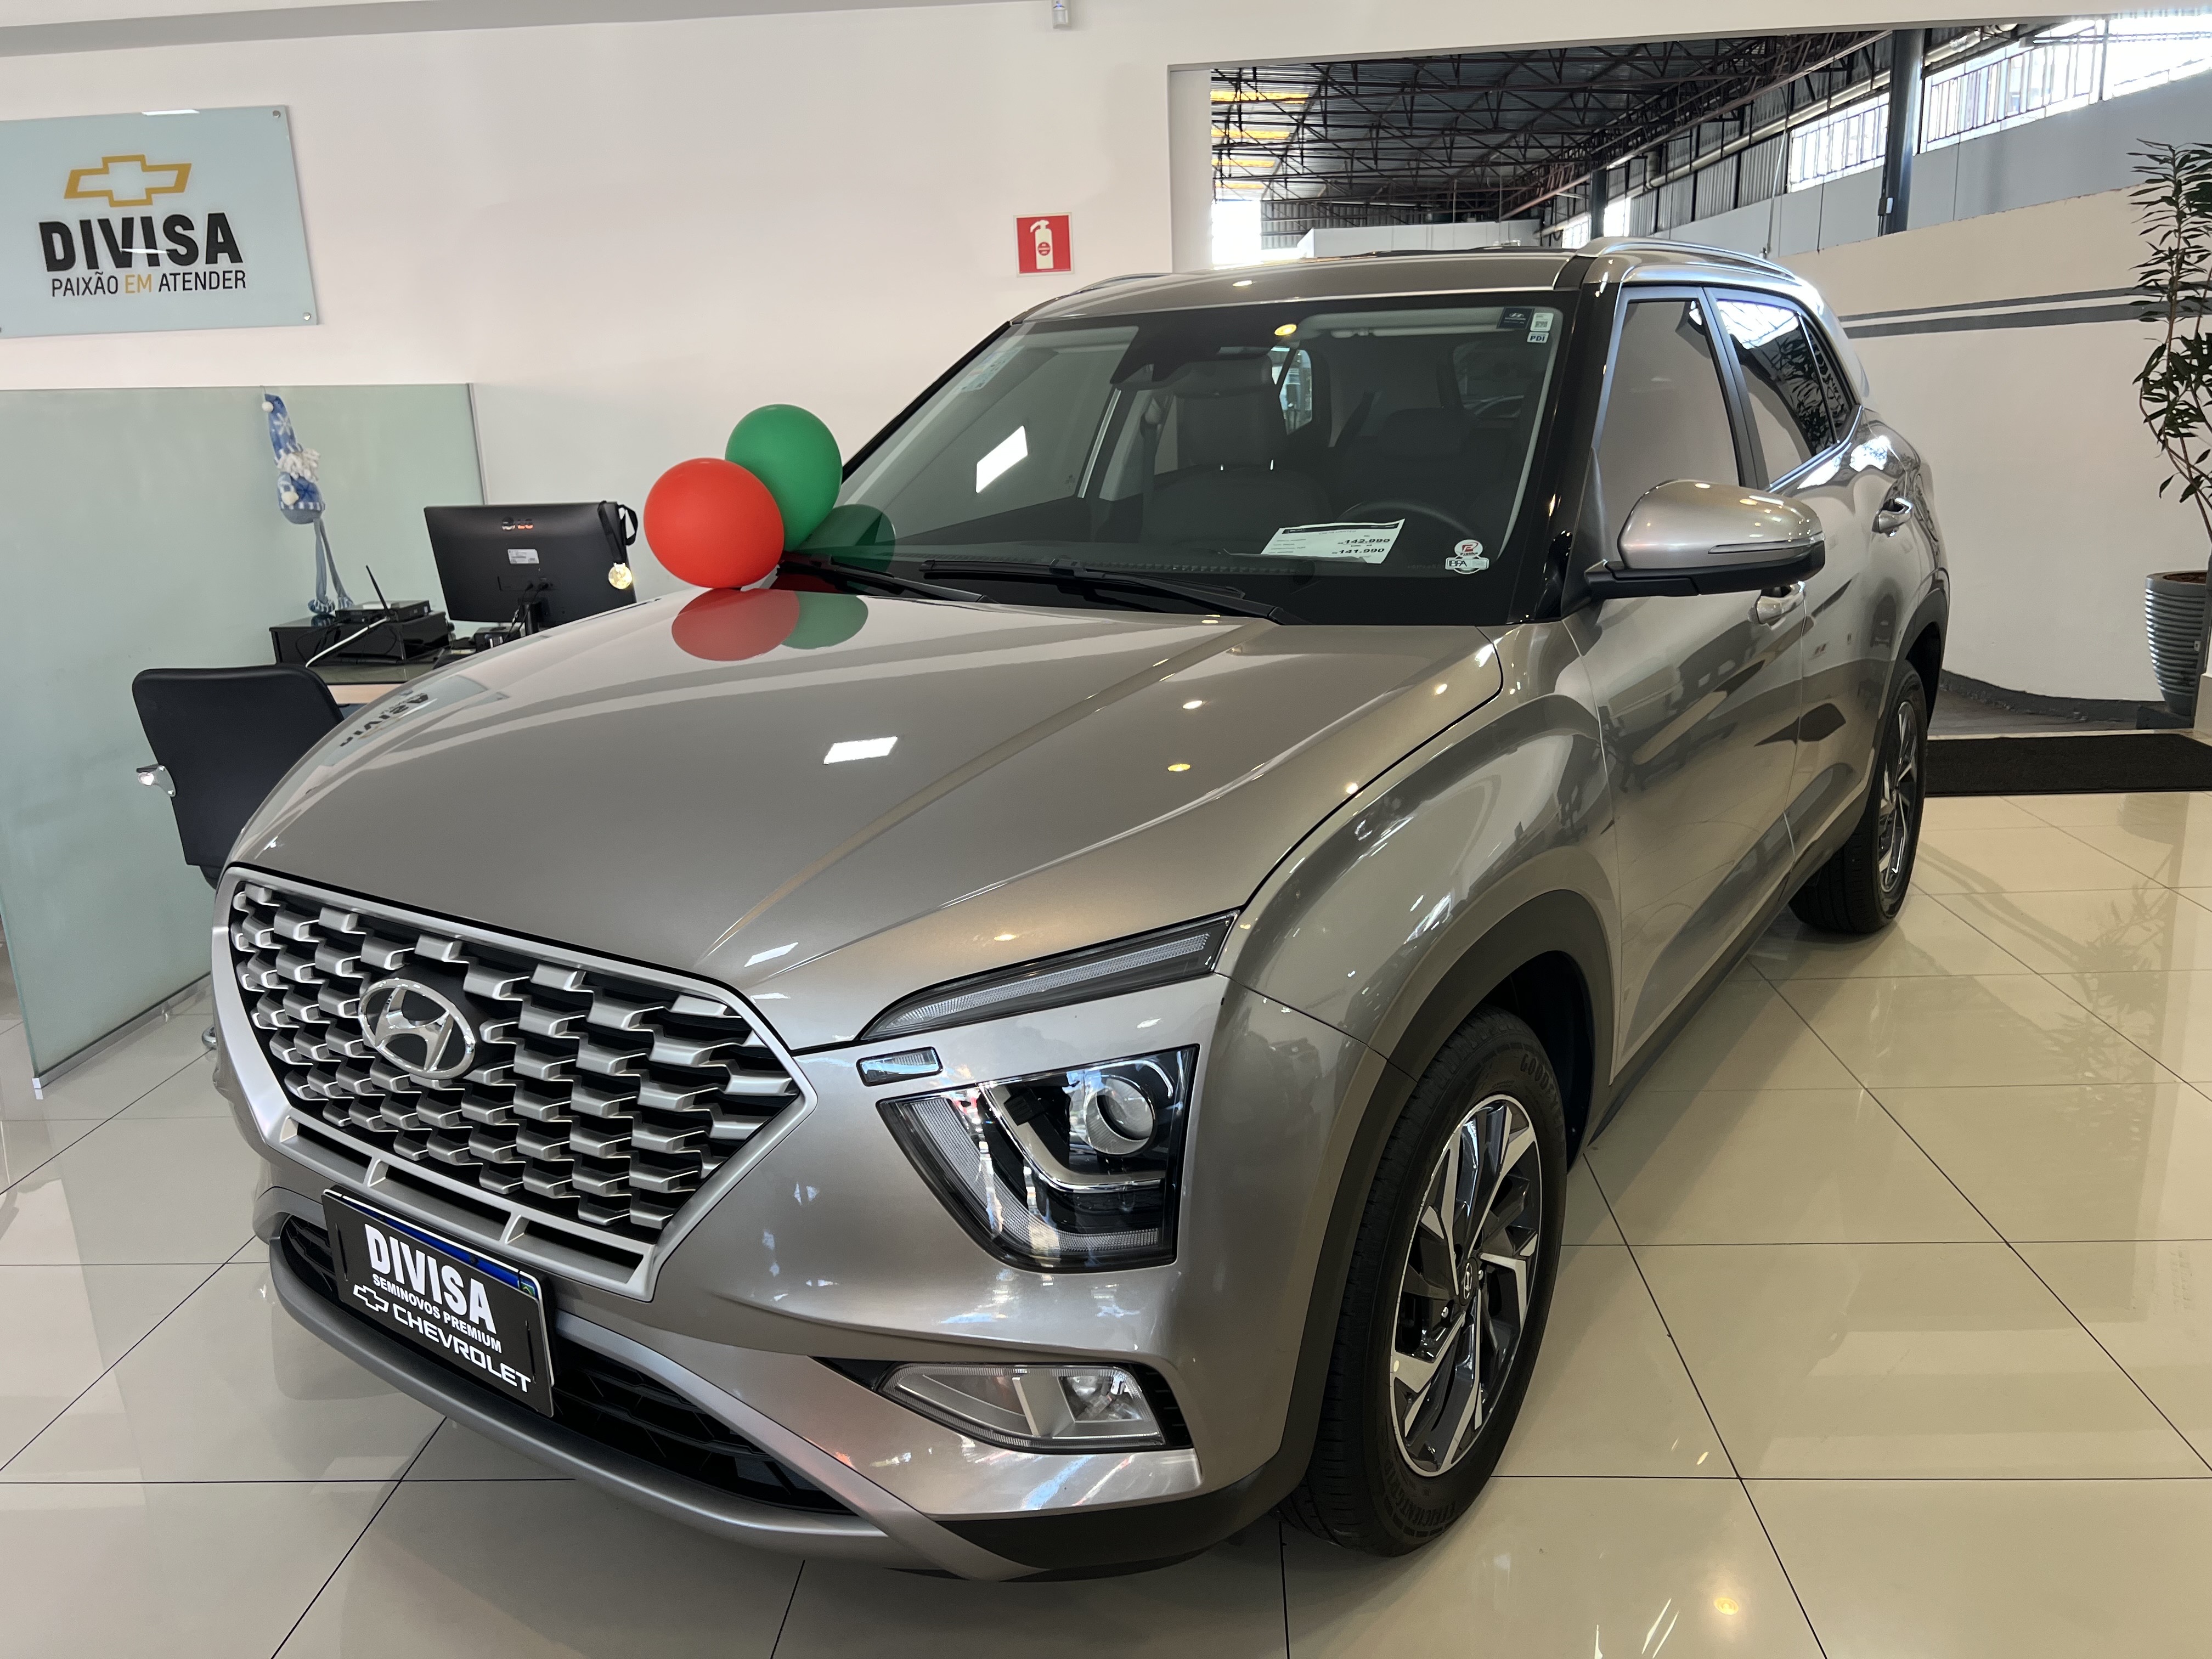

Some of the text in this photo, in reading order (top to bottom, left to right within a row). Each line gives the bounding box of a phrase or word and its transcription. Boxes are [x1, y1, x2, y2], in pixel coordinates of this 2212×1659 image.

[39, 212, 243, 272] DIVISA
[52, 270, 246, 297] PAIXÃO EM ATENDER
[365, 1223, 496, 1334] DIVISA
[373, 1273, 502, 1353] SEMINOVOS PREMIUM
[393, 1303, 531, 1392] CHEVROLET
